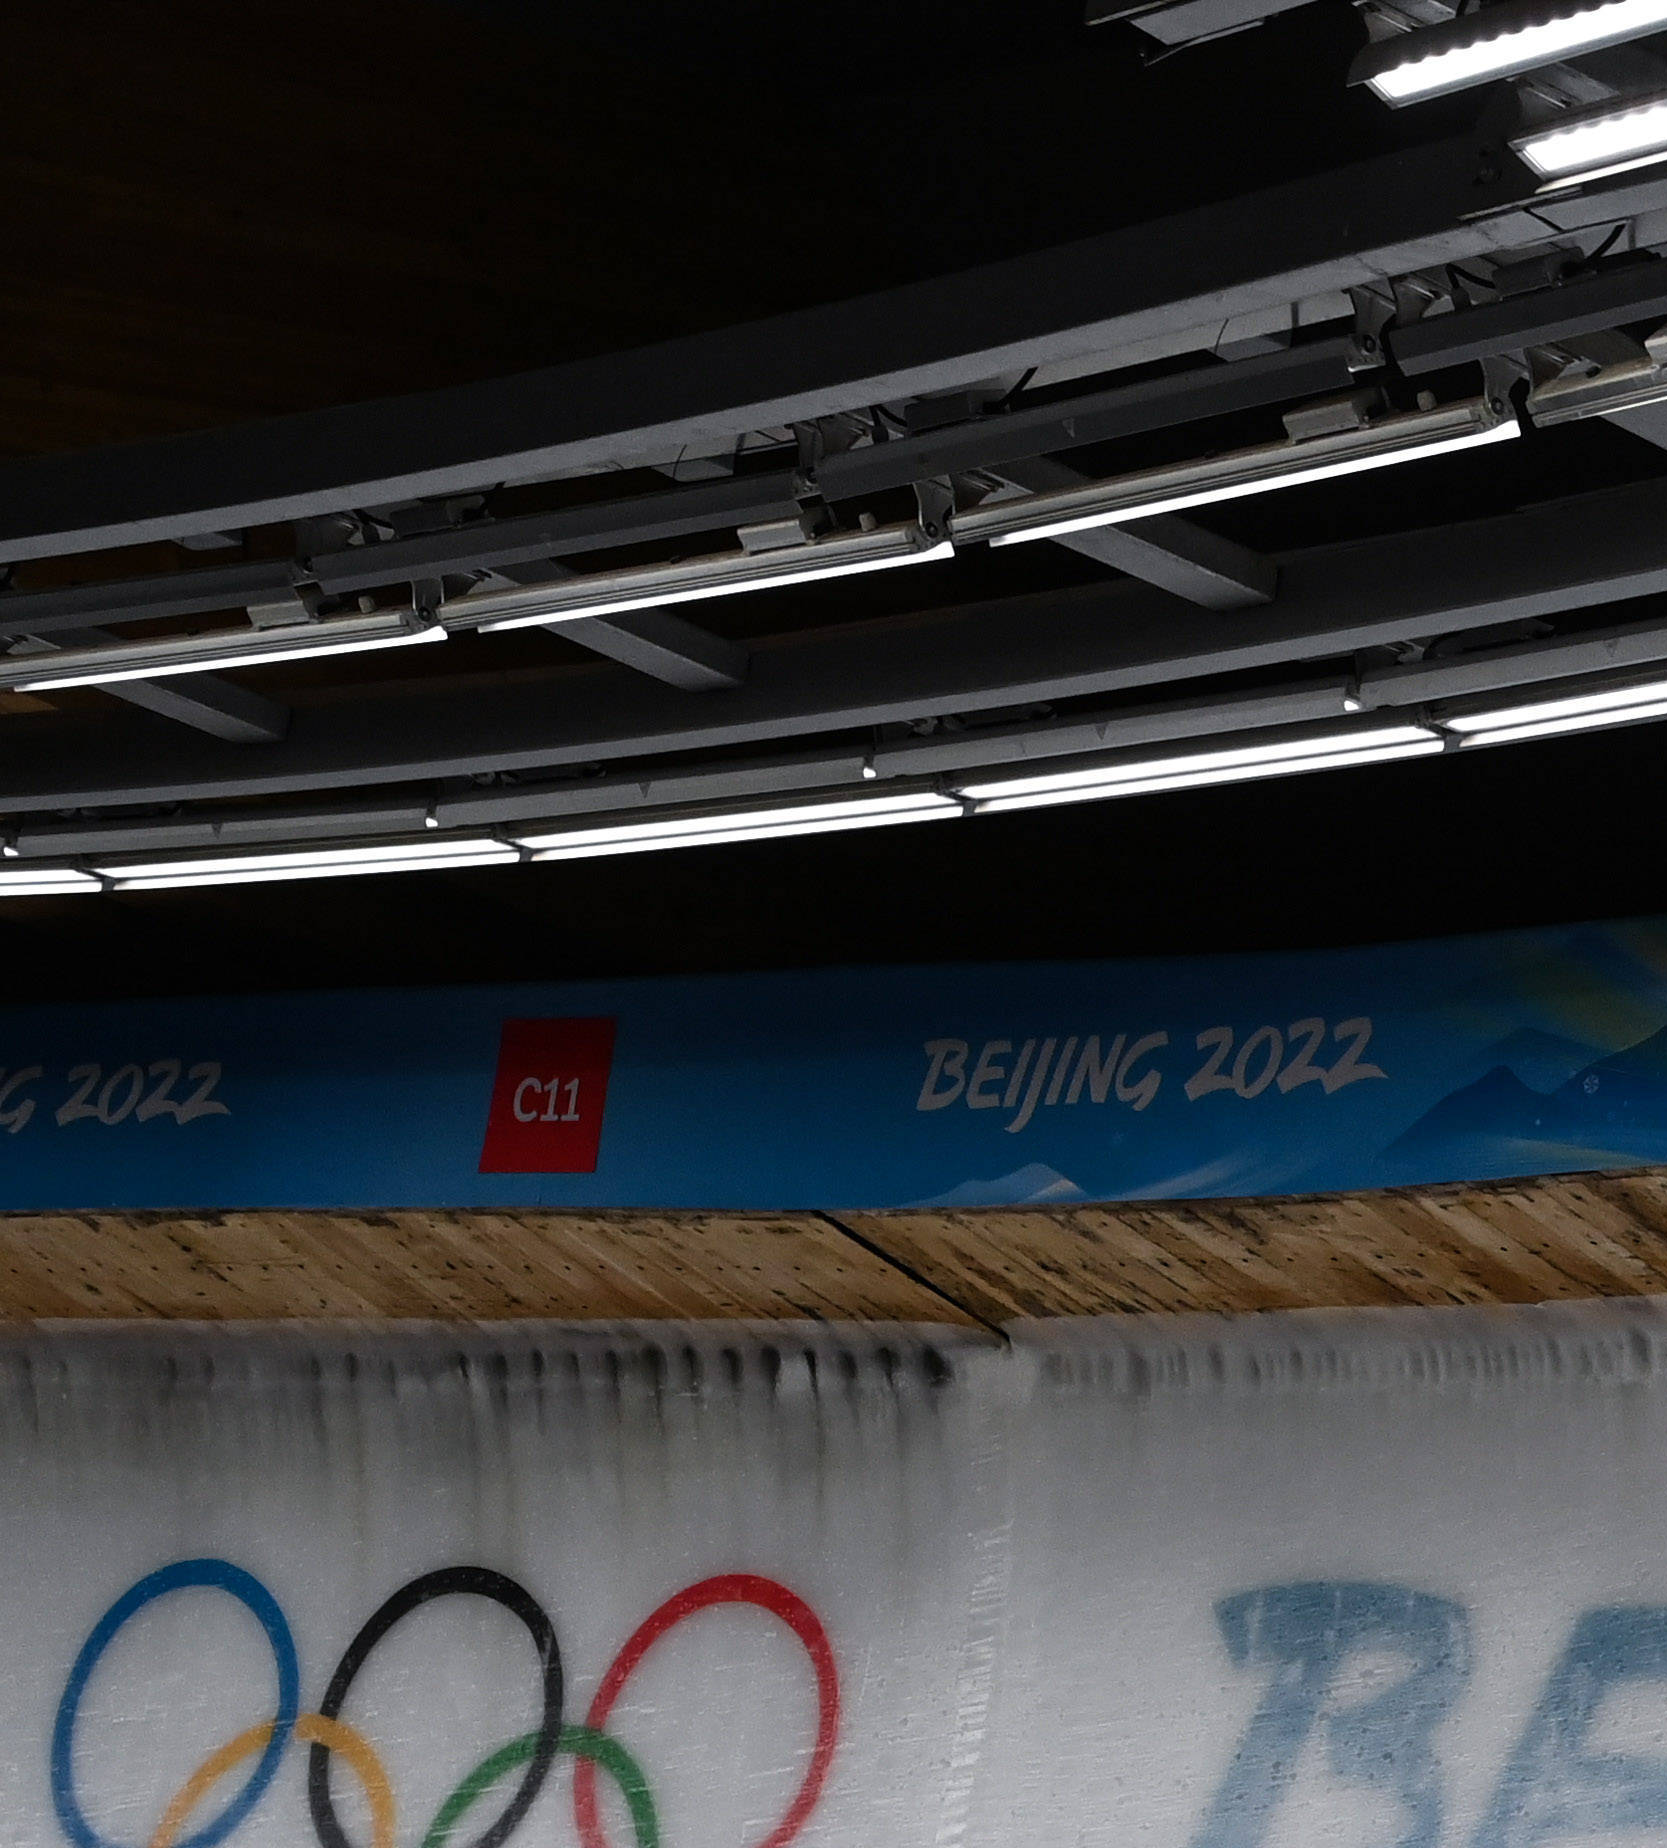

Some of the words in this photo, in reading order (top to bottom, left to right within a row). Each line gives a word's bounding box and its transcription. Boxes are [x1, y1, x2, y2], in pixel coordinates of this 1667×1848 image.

[55, 1058, 231, 1126] 2022
[512, 1077, 581, 1123] C11
[916, 1031, 1169, 1133] BEIJING
[1183, 1016, 1390, 1099] 2022
